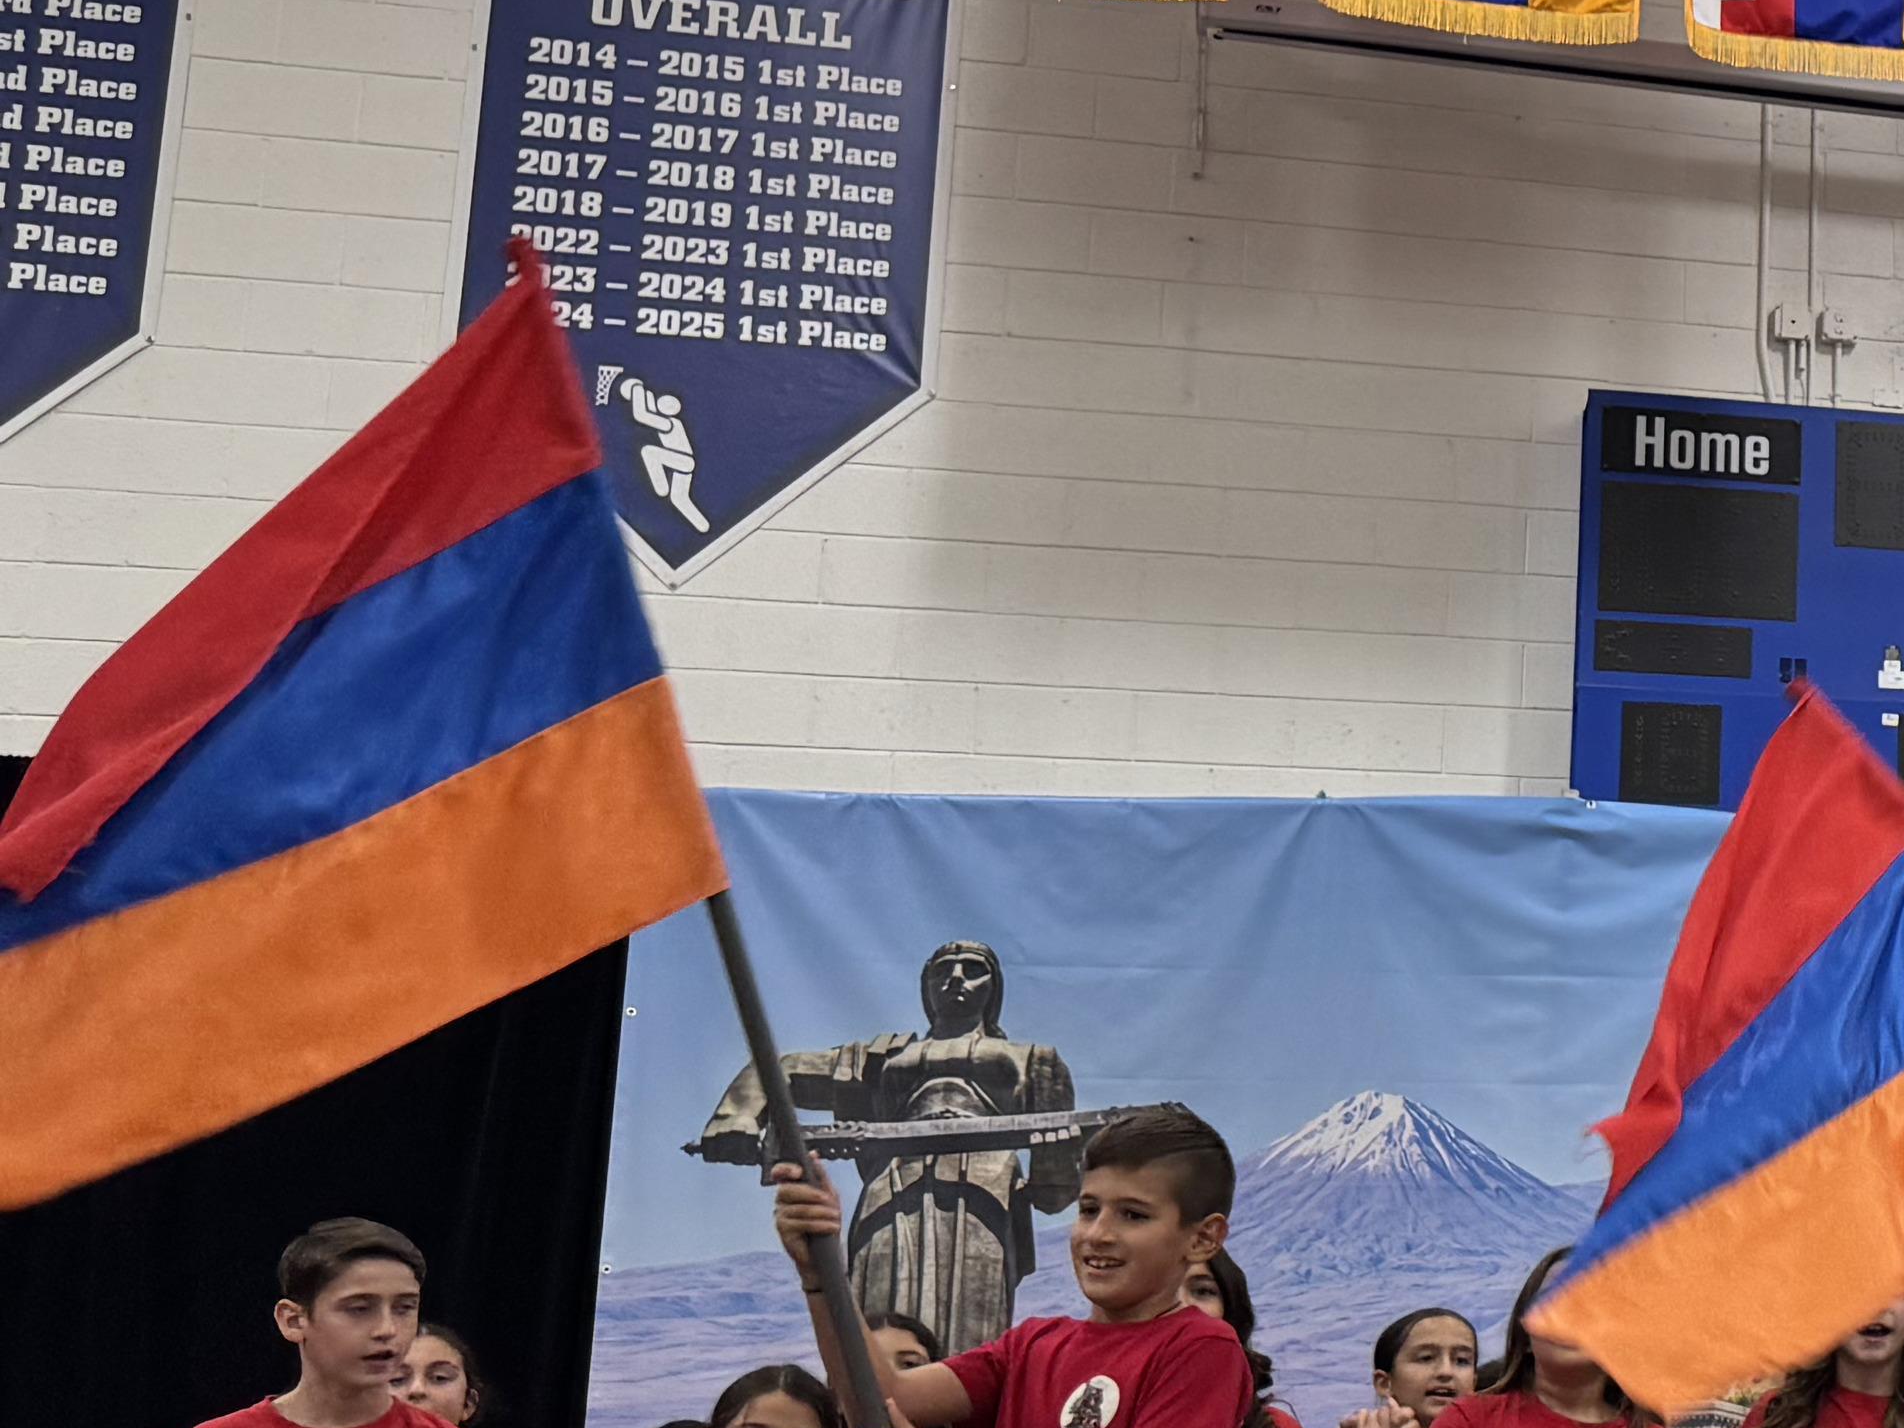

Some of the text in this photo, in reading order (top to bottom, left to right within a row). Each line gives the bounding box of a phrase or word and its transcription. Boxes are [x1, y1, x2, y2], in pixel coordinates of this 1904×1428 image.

[37, 28, 136, 62] Place
[528, 37, 902, 96] 2014 2015 1st Place
[39, 67, 138, 101] Place
[525, 74, 899, 132] 2015 2016 1st Place
[35, 106, 133, 140] Place
[520, 111, 897, 168] 2016 2017 1st Place
[24, 144, 125, 178] Place
[517, 148, 894, 205] 2017 2018 1st Place
[18, 184, 118, 217] Place
[512, 186, 892, 241] 2018 2019 1st Place
[14, 223, 118, 258] Place
[641, 234, 730, 265] 2023
[743, 242, 791, 270] 1st
[802, 246, 889, 277] Place
[7, 261, 107, 296] Place
[637, 272, 726, 303] 2024
[740, 280, 788, 308] 1st
[799, 284, 887, 315] Place
[636, 308, 724, 339] 2025
[739, 315, 787, 344] 1st
[798, 320, 886, 351] Place
[1634, 414, 1772, 477] Home
